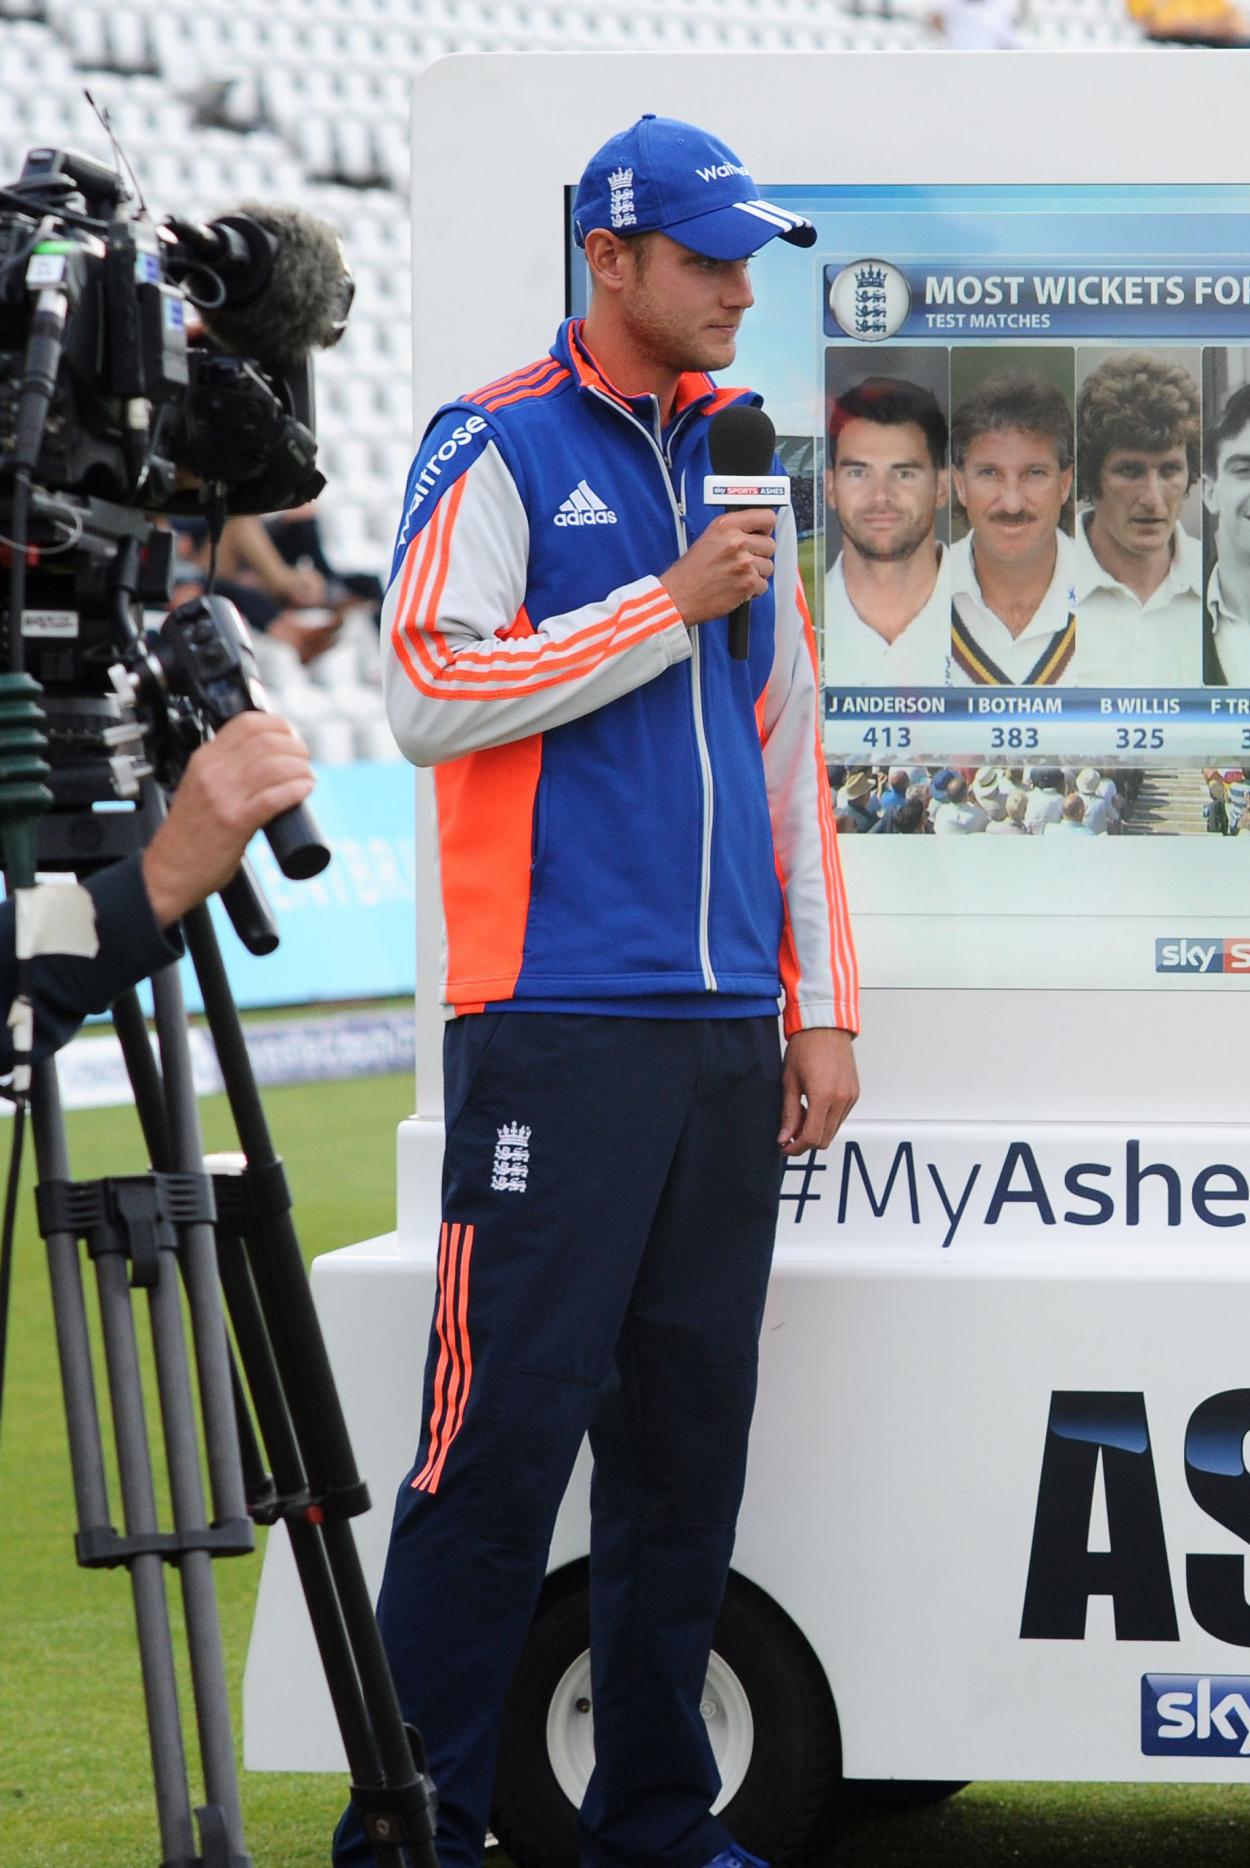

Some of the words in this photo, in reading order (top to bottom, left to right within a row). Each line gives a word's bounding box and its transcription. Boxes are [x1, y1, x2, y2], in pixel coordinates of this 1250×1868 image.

[695, 161, 749, 183] Wait
[925, 275, 1025, 305] MOST
[1032, 275, 1185, 305] WICKETS
[926, 313, 966, 328] TEST
[970, 313, 1050, 328] MATCHES
[714, 487, 726, 495] sky
[726, 487, 759, 495] SPORTS
[553, 509, 618, 527] adidas
[829, 697, 837, 714] J
[842, 696, 945, 714] ANDERSON
[968, 697, 973, 713] I
[978, 697, 1063, 714] BOTHAM
[1100, 698, 1112, 713] B
[1117, 698, 1181, 714] WILLIS
[1211, 699, 1221, 714] F
[862, 727, 912, 748] 413
[991, 727, 1040, 748] 383
[1116, 728, 1164, 749] 325
[1162, 939, 1217, 972] sky
